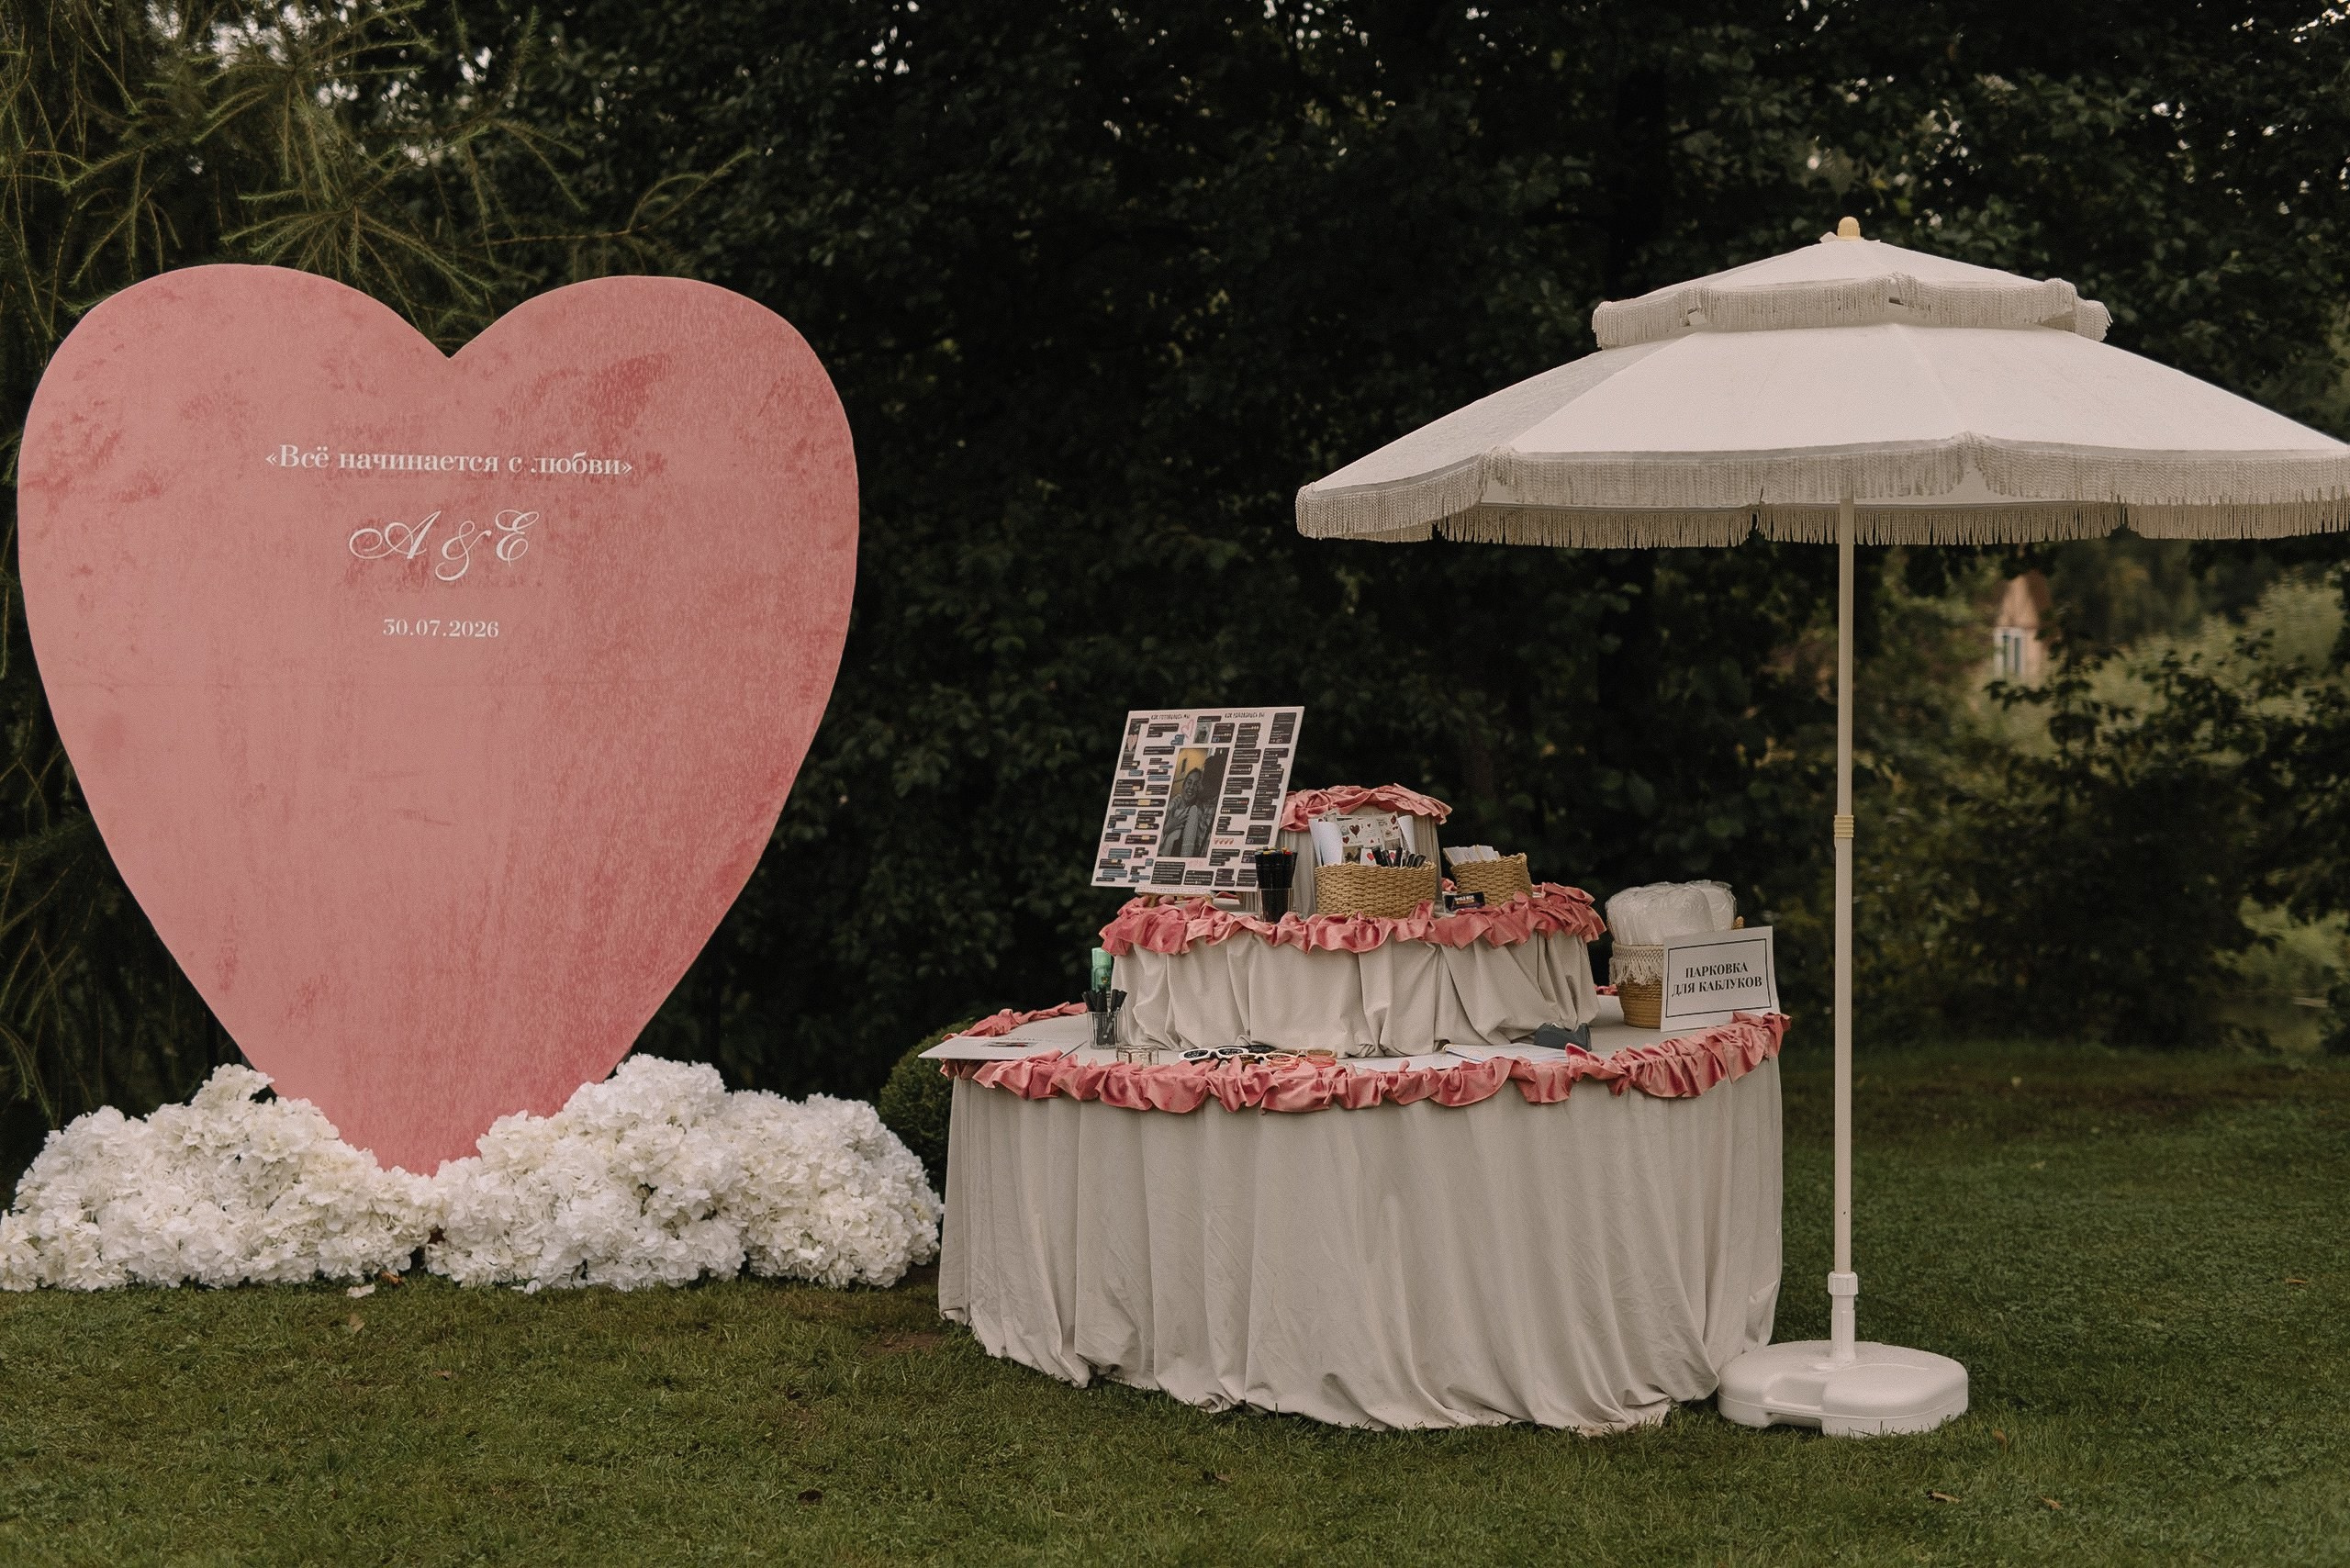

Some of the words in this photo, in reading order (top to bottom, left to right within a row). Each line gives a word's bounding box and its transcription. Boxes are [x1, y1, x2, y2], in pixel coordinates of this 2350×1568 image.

[265, 443, 330, 468] «Всё
[339, 452, 499, 473] начинается
[509, 456, 522, 473] с
[530, 450, 633, 476] любви»
[382, 618, 499, 639] 30.07.2026
[1685, 962, 1748, 978] ПАРКОВКА
[1671, 982, 1695, 997] ДЛЯ
[1698, 976, 1762, 991] КАБЛУКОВ
